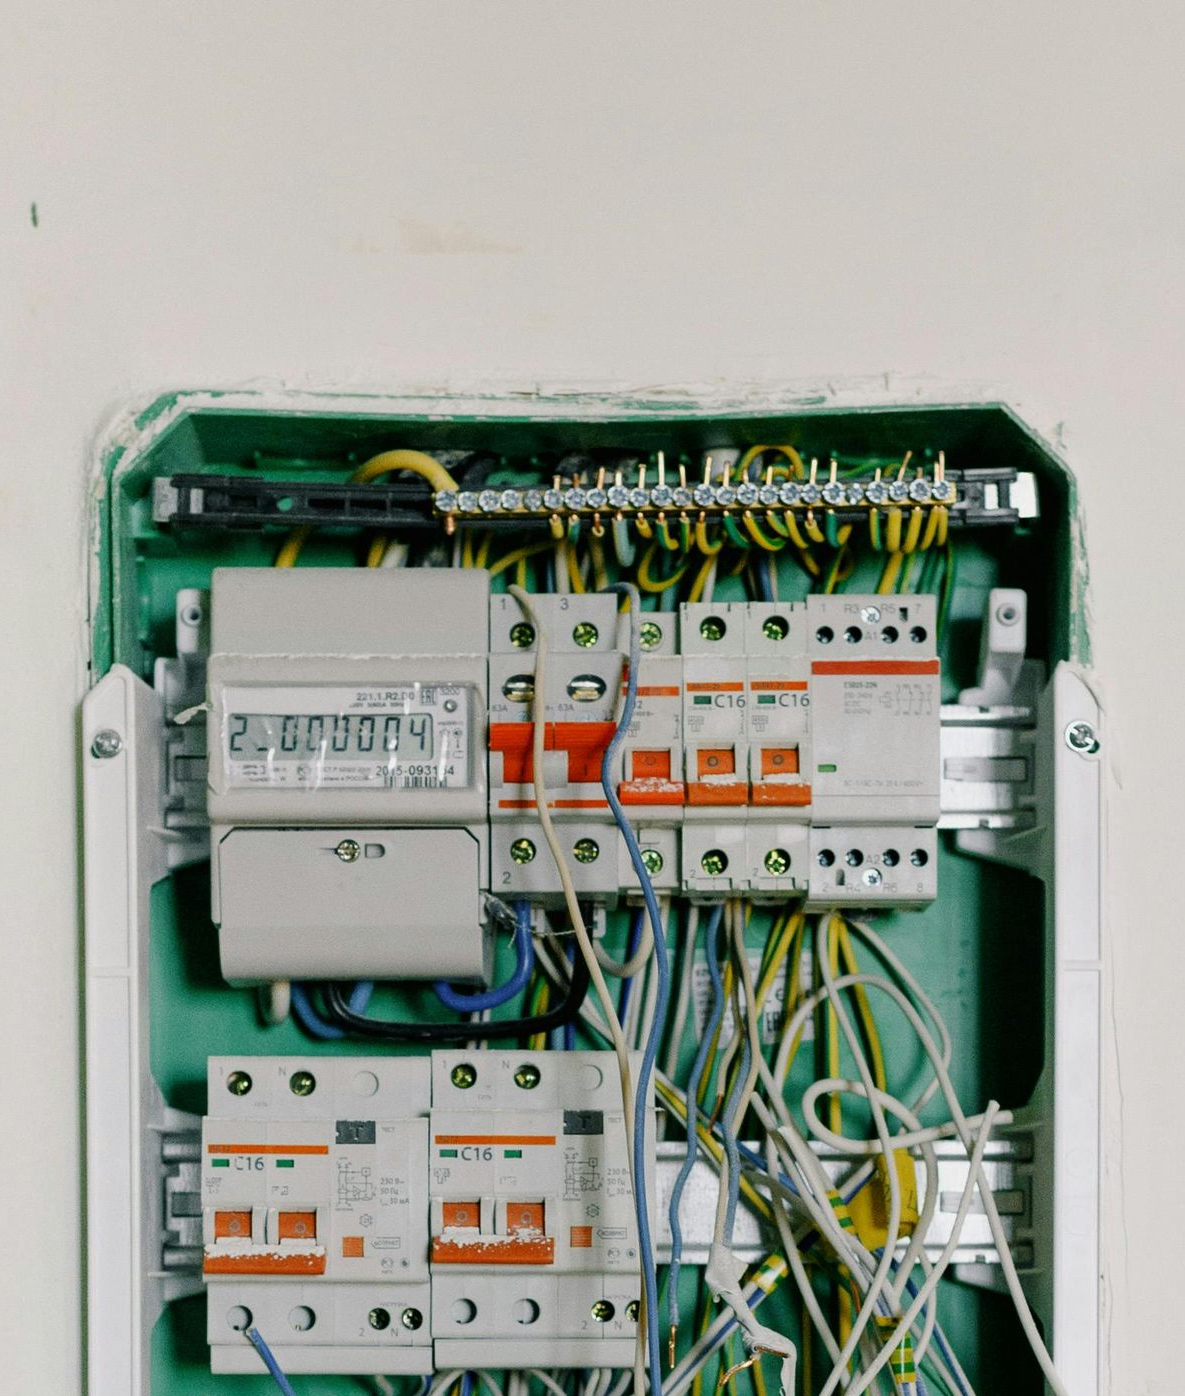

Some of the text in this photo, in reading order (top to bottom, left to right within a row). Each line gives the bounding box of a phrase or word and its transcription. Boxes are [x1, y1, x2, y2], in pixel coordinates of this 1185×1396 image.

[560, 598, 569, 610] 3
[714, 694, 746, 708] C16
[778, 693, 810, 707] C16
[502, 872, 512, 884] 2
[461, 1146, 493, 1161] C16
[235, 1156, 265, 1171] C16
